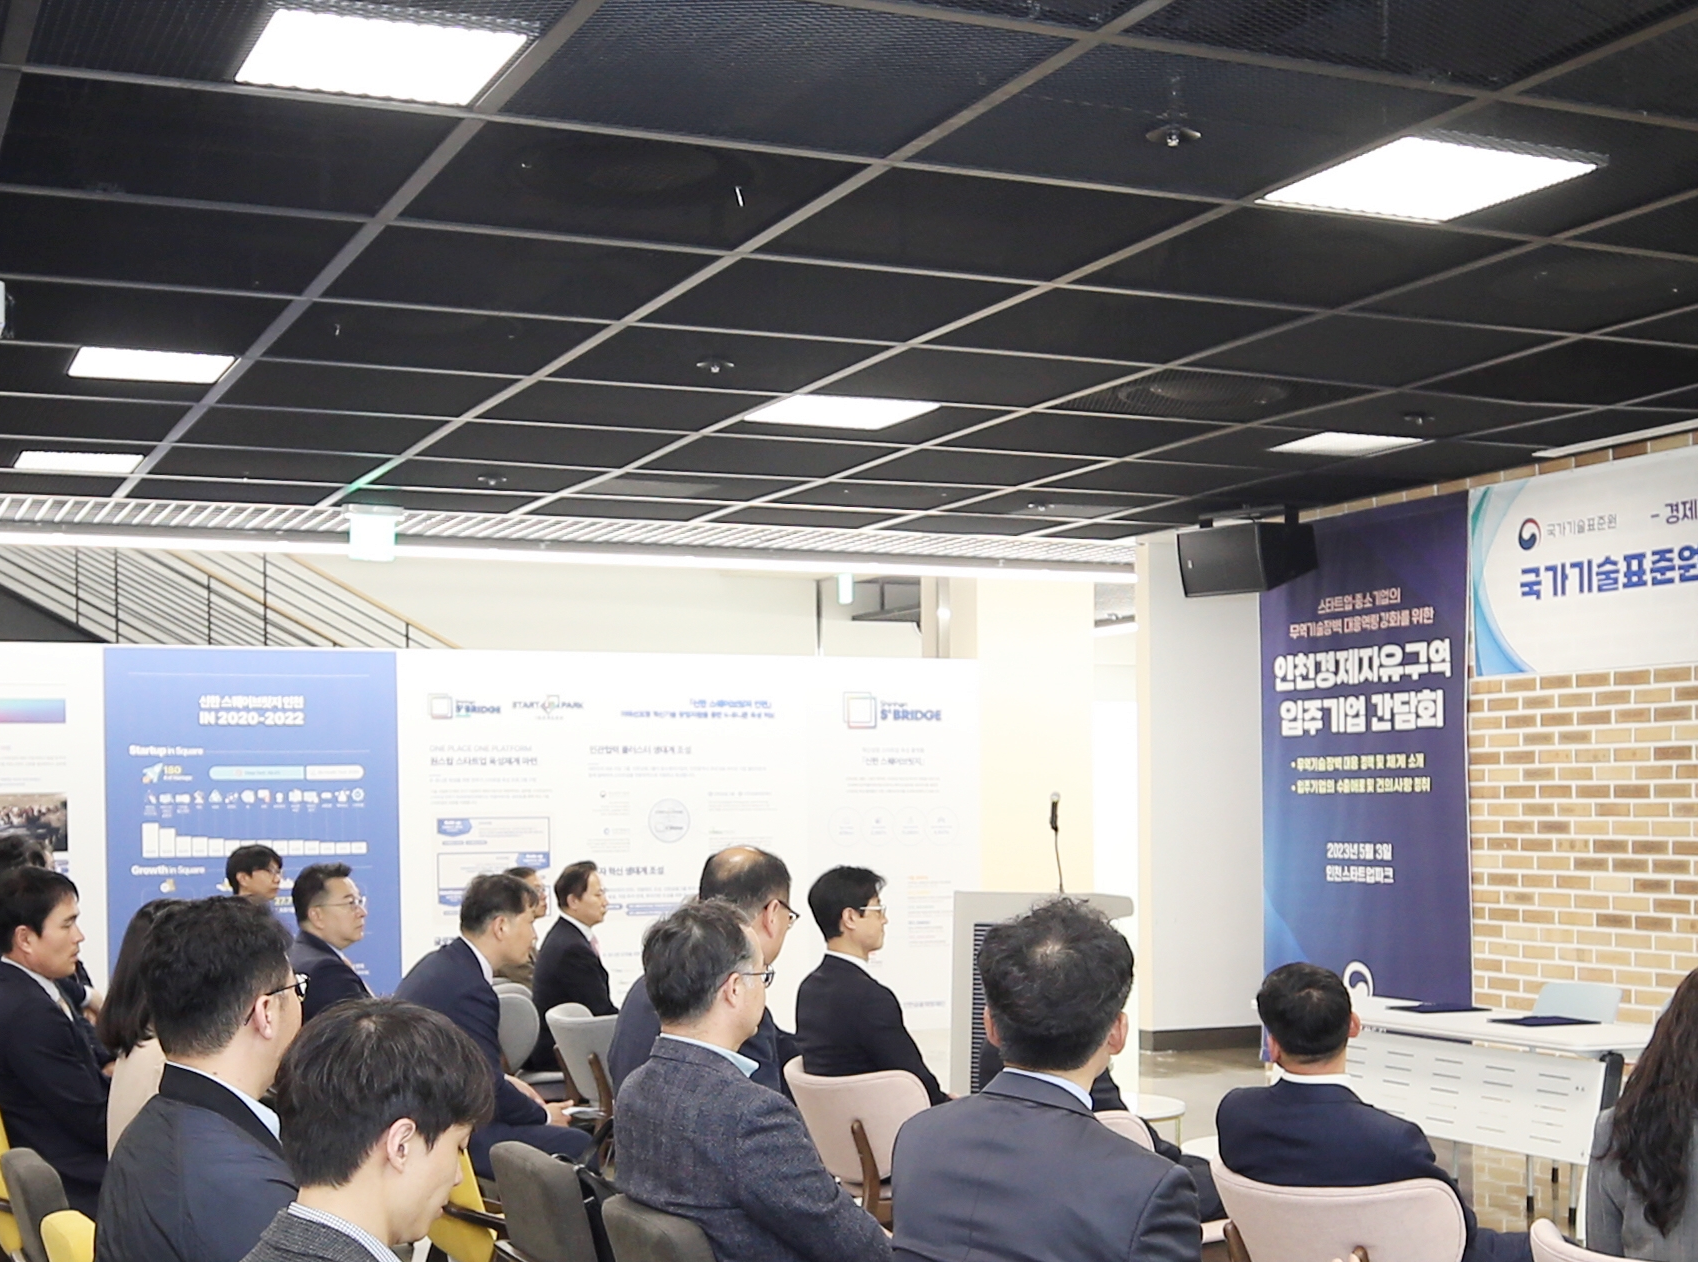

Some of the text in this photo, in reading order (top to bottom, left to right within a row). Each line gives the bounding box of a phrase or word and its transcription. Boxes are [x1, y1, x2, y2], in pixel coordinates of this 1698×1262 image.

[1545, 514, 1618, 539] 국가기술표준원
[1411, 606, 1434, 625] 위한
[1274, 638, 1452, 692] 인천경제자유구역
[199, 711, 305, 726] IN 2020-2022
[1279, 688, 1445, 737] 입주기업 간담회
[129, 745, 166, 757] Startup
[175, 747, 204, 757] Square
[1326, 842, 1393, 861] 2023년 5월 3일
[131, 866, 168, 876] Growth
[176, 867, 205, 876] Square
[1325, 865, 1394, 883] 인천스타트업파크
